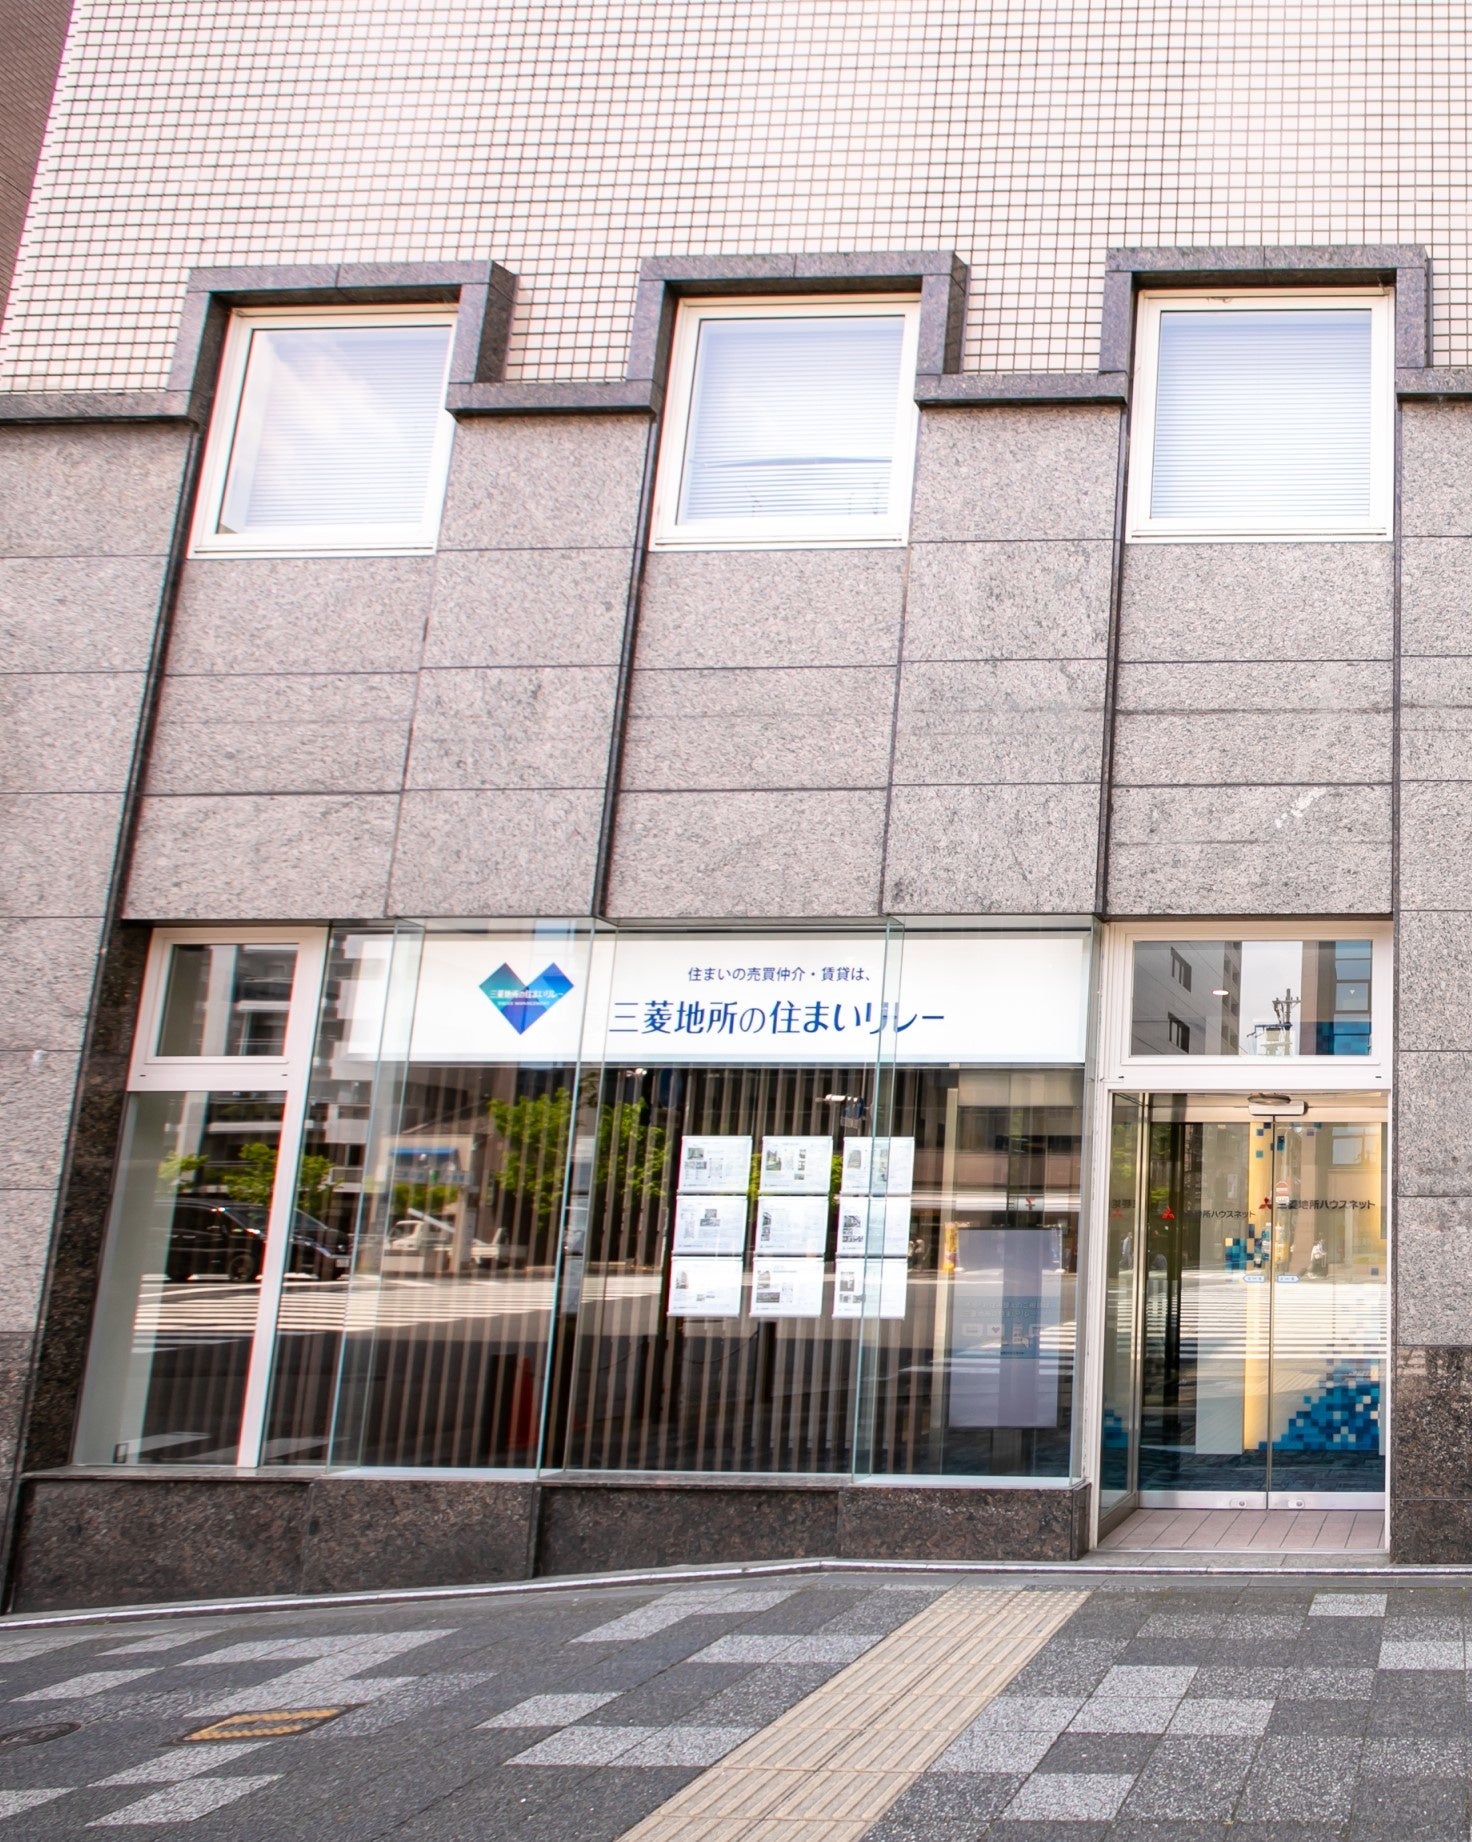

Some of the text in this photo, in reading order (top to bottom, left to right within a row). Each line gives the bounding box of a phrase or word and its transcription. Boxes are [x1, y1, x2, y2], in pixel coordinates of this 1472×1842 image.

[687, 967, 871, 982] 住まいの売買仲介・賃貸は、
[608, 1000, 945, 1035] 三菱地所の住まいリレー
